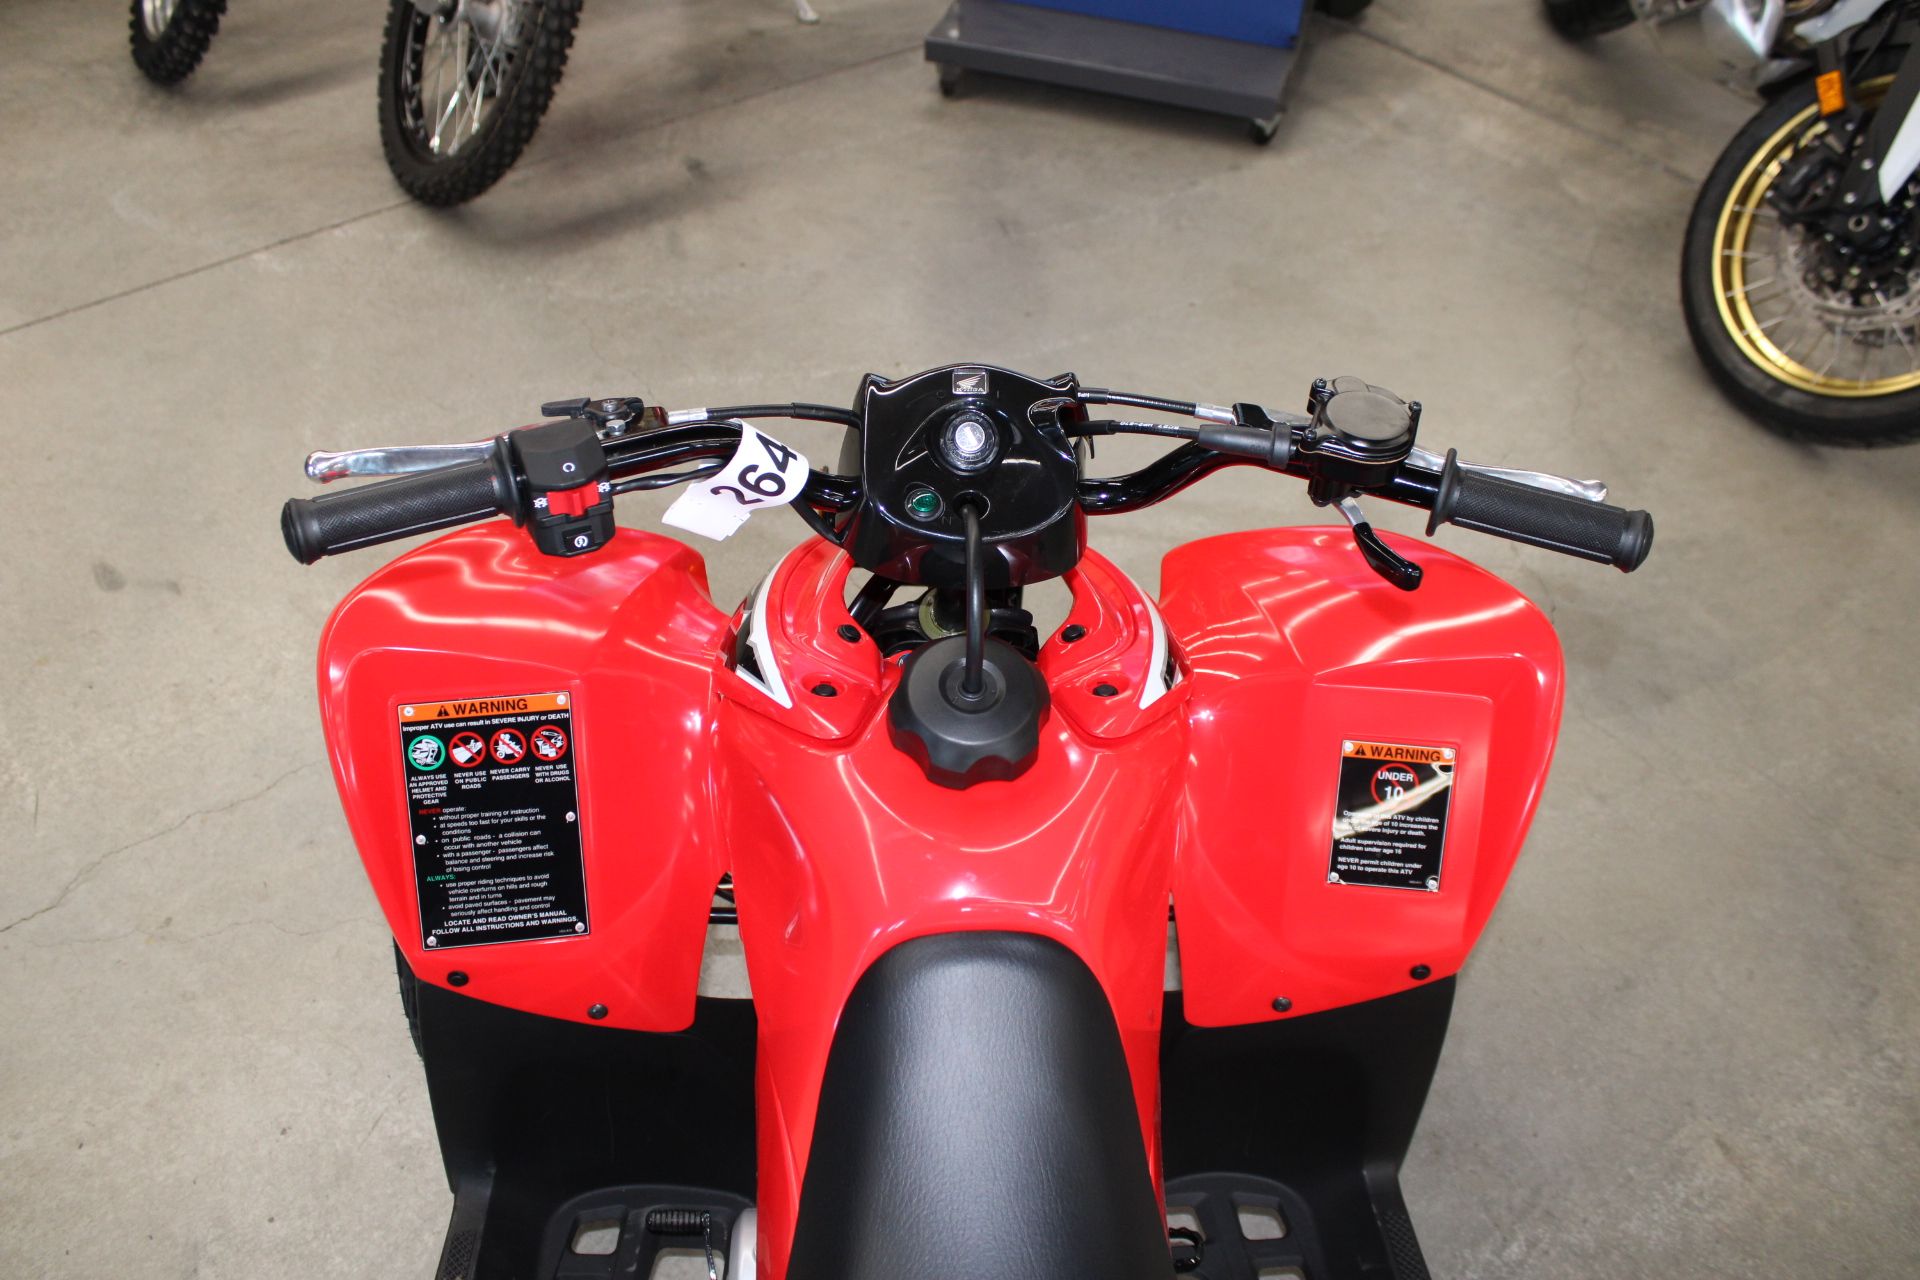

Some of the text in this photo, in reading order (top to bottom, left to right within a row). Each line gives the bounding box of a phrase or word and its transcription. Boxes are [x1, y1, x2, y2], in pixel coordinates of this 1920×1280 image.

[711, 432, 798, 505] 264
[452, 698, 528, 716] WARNING
[1370, 746, 1440, 762] WARNING
[492, 773, 529, 781] PASSENGERS
[1378, 771, 1414, 782] UNDER
[1384, 786, 1403, 800] 10
[498, 846, 531, 854] passengers
[482, 855, 505, 863] steering
[494, 906, 518, 914] handling
[508, 913, 538, 921] OWNER'S
[432, 927, 460, 935] FOLLOW
[476, 921, 524, 931] INSTRUCTIONS
[541, 916, 578, 924] WARNINGS.
